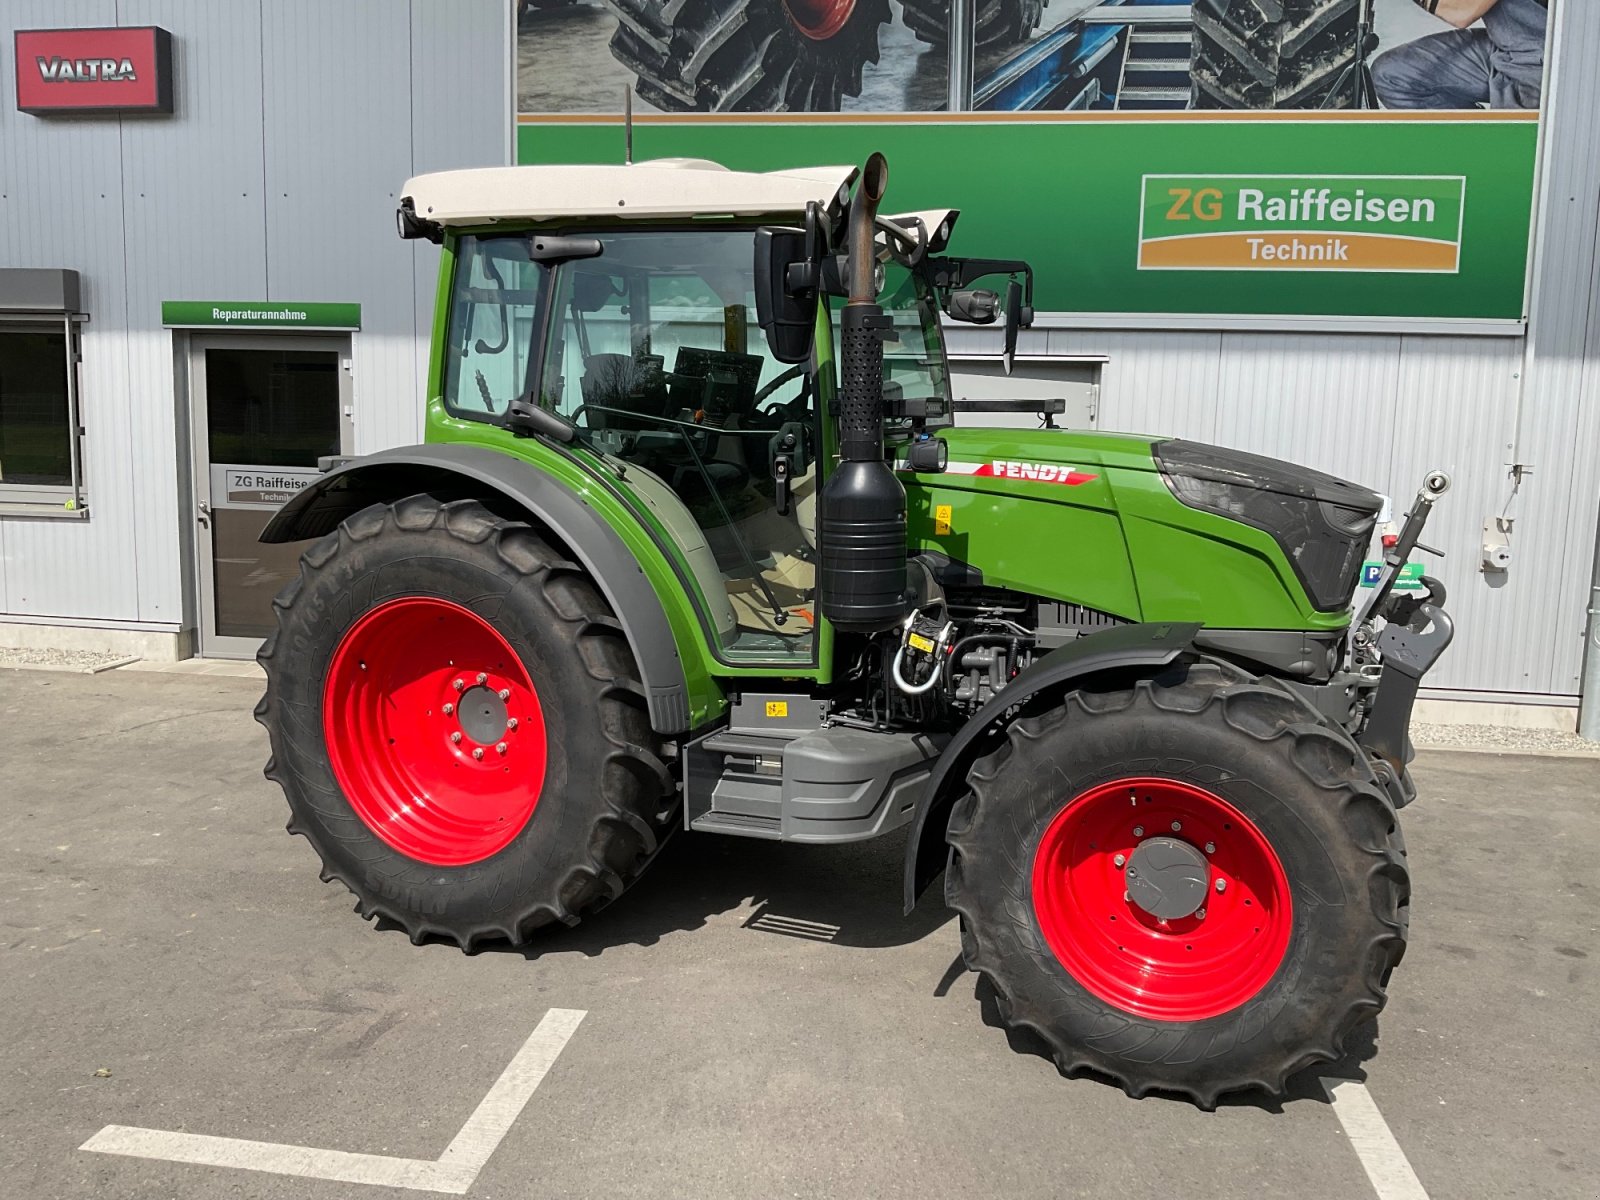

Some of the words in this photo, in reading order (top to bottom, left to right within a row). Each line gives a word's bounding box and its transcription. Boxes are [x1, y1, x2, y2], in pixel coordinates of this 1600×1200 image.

[36, 56, 137, 82] VALTRA
[1165, 187, 1224, 221] ZG
[1237, 188, 1436, 222] Raiffeisen
[1246, 238, 1348, 261] Technik
[213, 307, 306, 322] Reparaturannahme
[235, 475, 252, 487] ZG
[256, 477, 310, 489] Raiffeise
[992, 460, 1076, 482] FENDT
